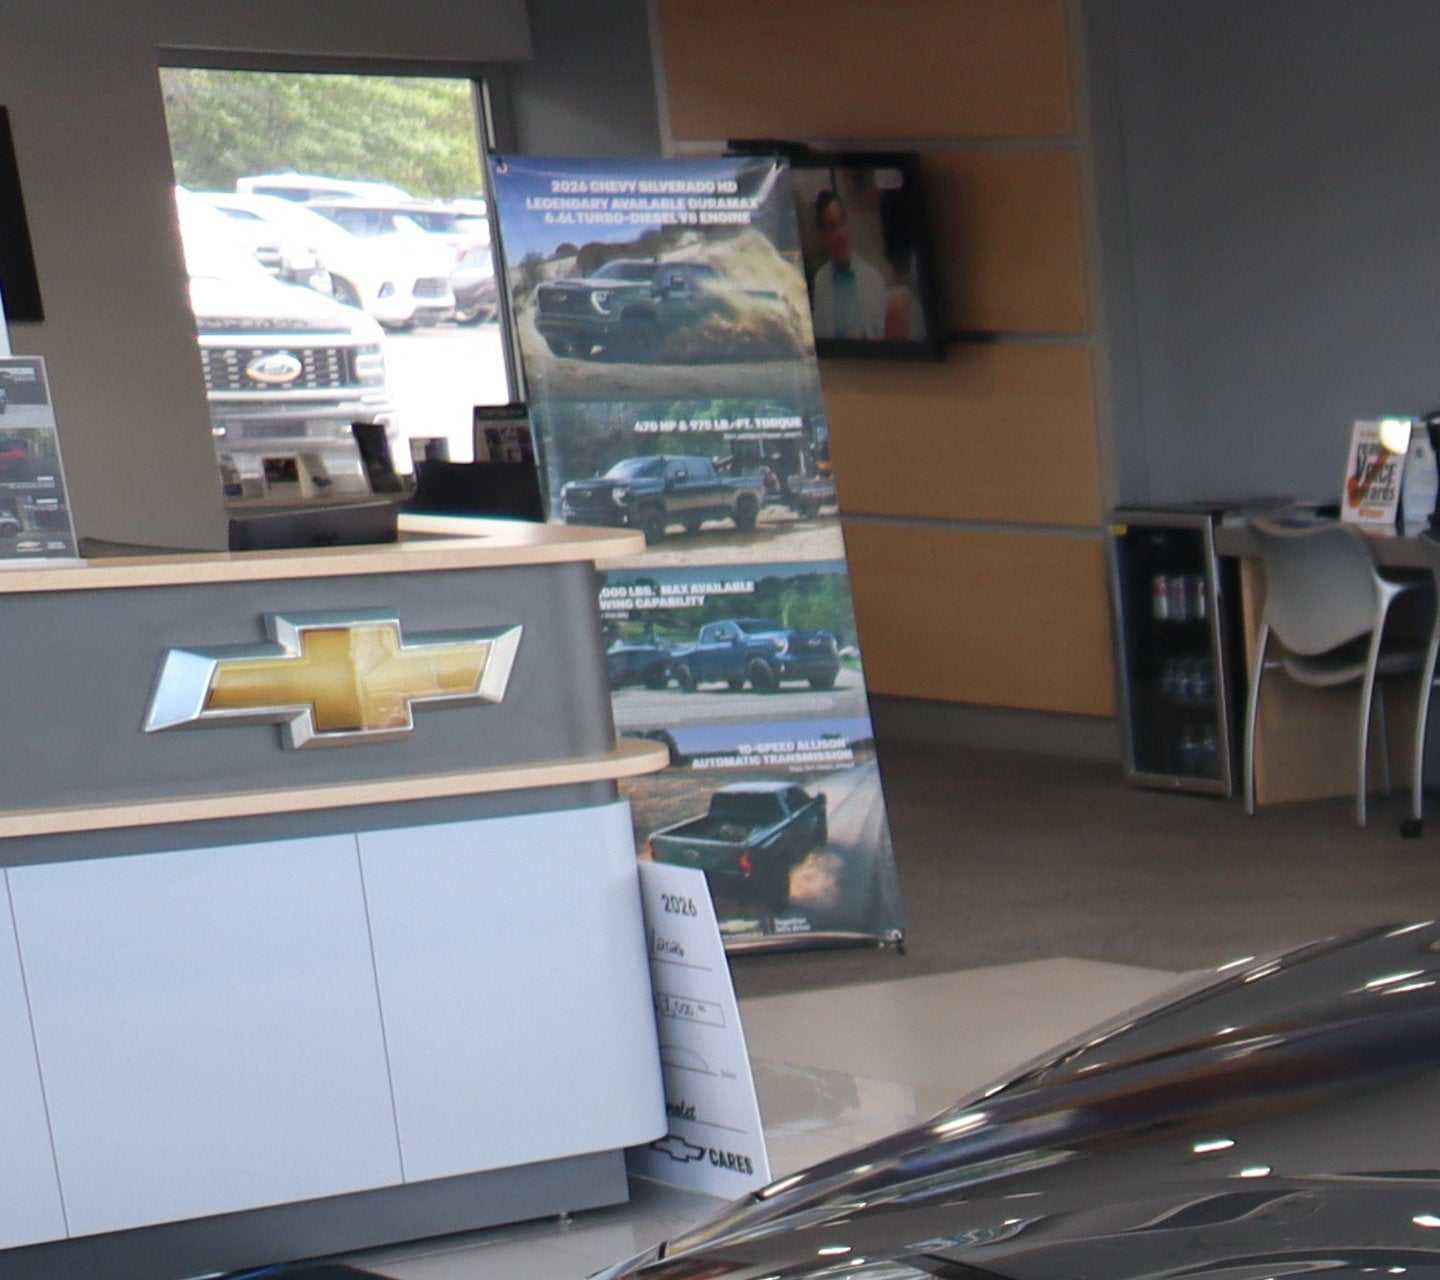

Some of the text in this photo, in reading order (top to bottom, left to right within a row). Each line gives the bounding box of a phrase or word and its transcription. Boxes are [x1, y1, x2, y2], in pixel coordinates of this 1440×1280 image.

[552, 180, 738, 193] 2026 CHEVY SILVERADO HD
[526, 197, 760, 210] LEGENDARY AVAILABLE DURAMAX
[577, 212, 678, 224] TURBO-DIESEL
[680, 212, 697, 225] V8
[700, 212, 751, 225] ENGINE
[755, 416, 803, 429] TORQUE
[660, 583, 689, 595] MAX
[690, 581, 755, 594] AVAILABLE
[599, 595, 706, 611] WING CAPABILITY
[692, 748, 854, 770] AUTOMATIC TRANSMISSION
[660, 893, 698, 917] 2026
[708, 1148, 754, 1176] CARES
